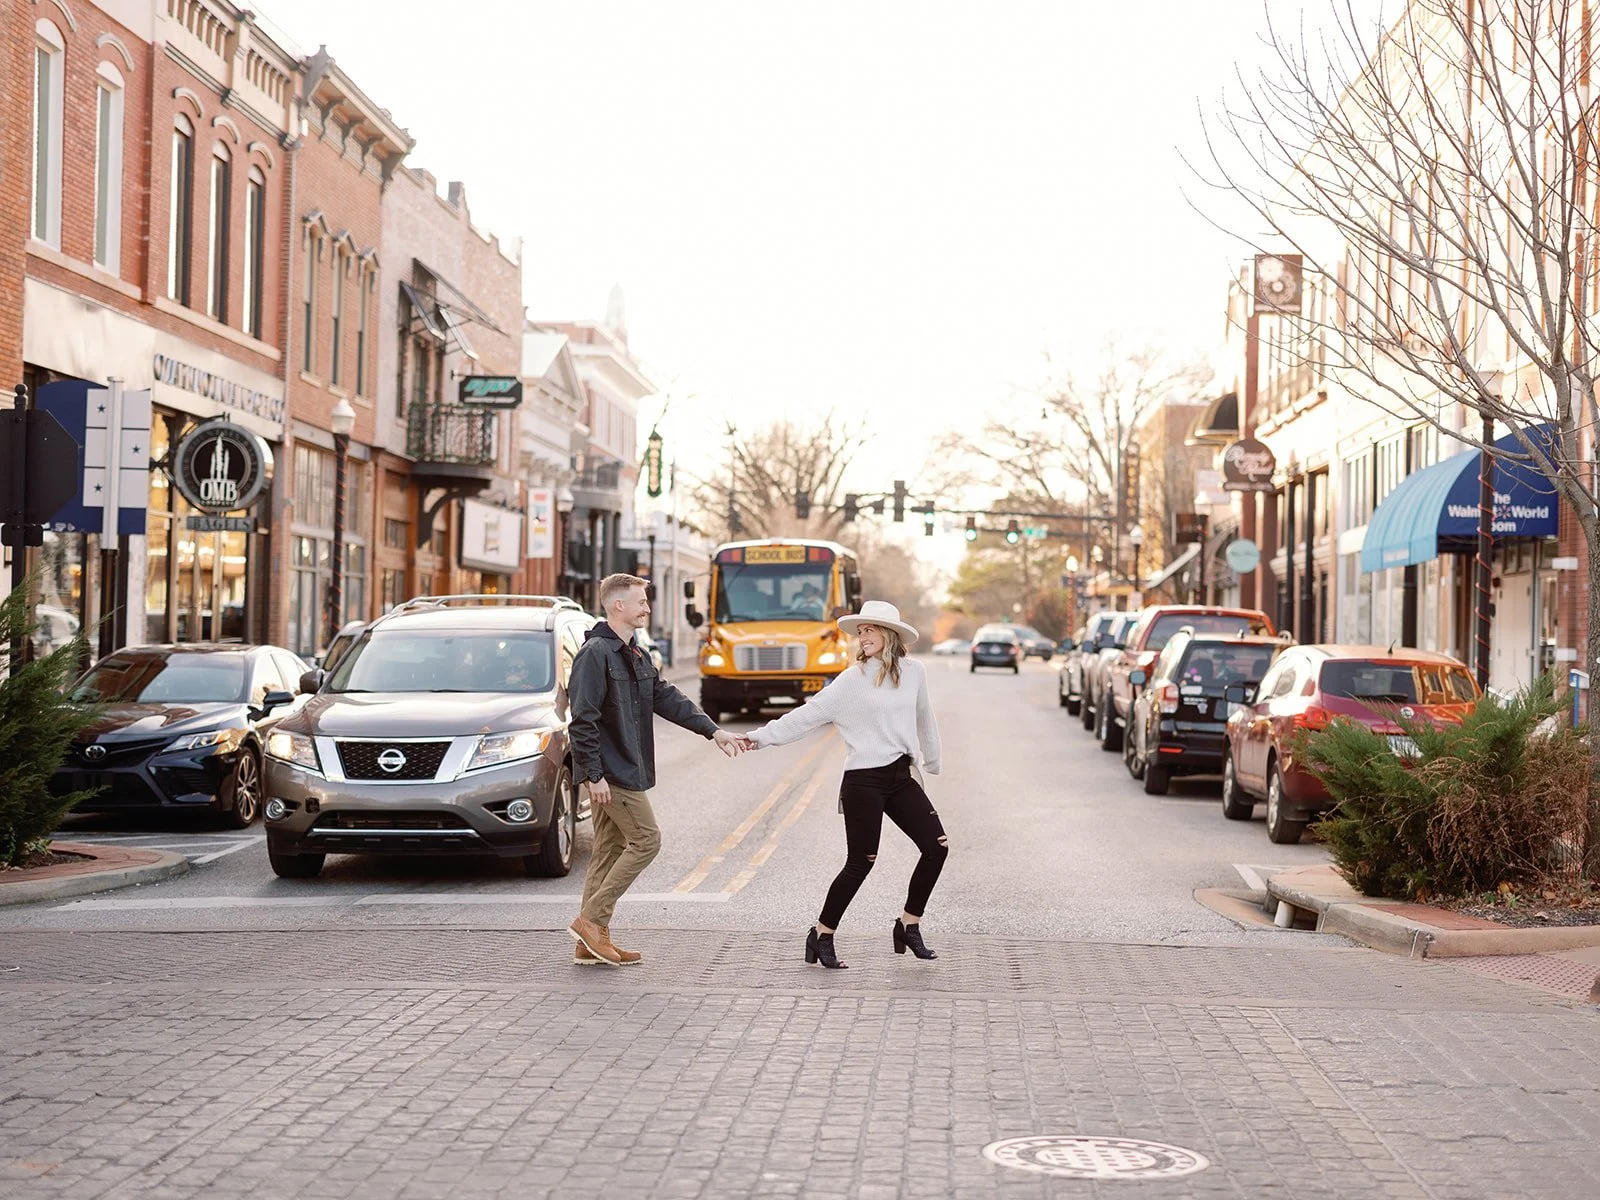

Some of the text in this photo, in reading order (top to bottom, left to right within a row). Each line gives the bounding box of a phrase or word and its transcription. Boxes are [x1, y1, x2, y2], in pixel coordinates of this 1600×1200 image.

[200, 479, 238, 501] OMB
[1494, 492, 1511, 504] he
[1448, 504, 1549, 518] Walmt World
[193, 518, 250, 531] BAGELS
[747, 550, 804, 561] SCHOOL BUS
